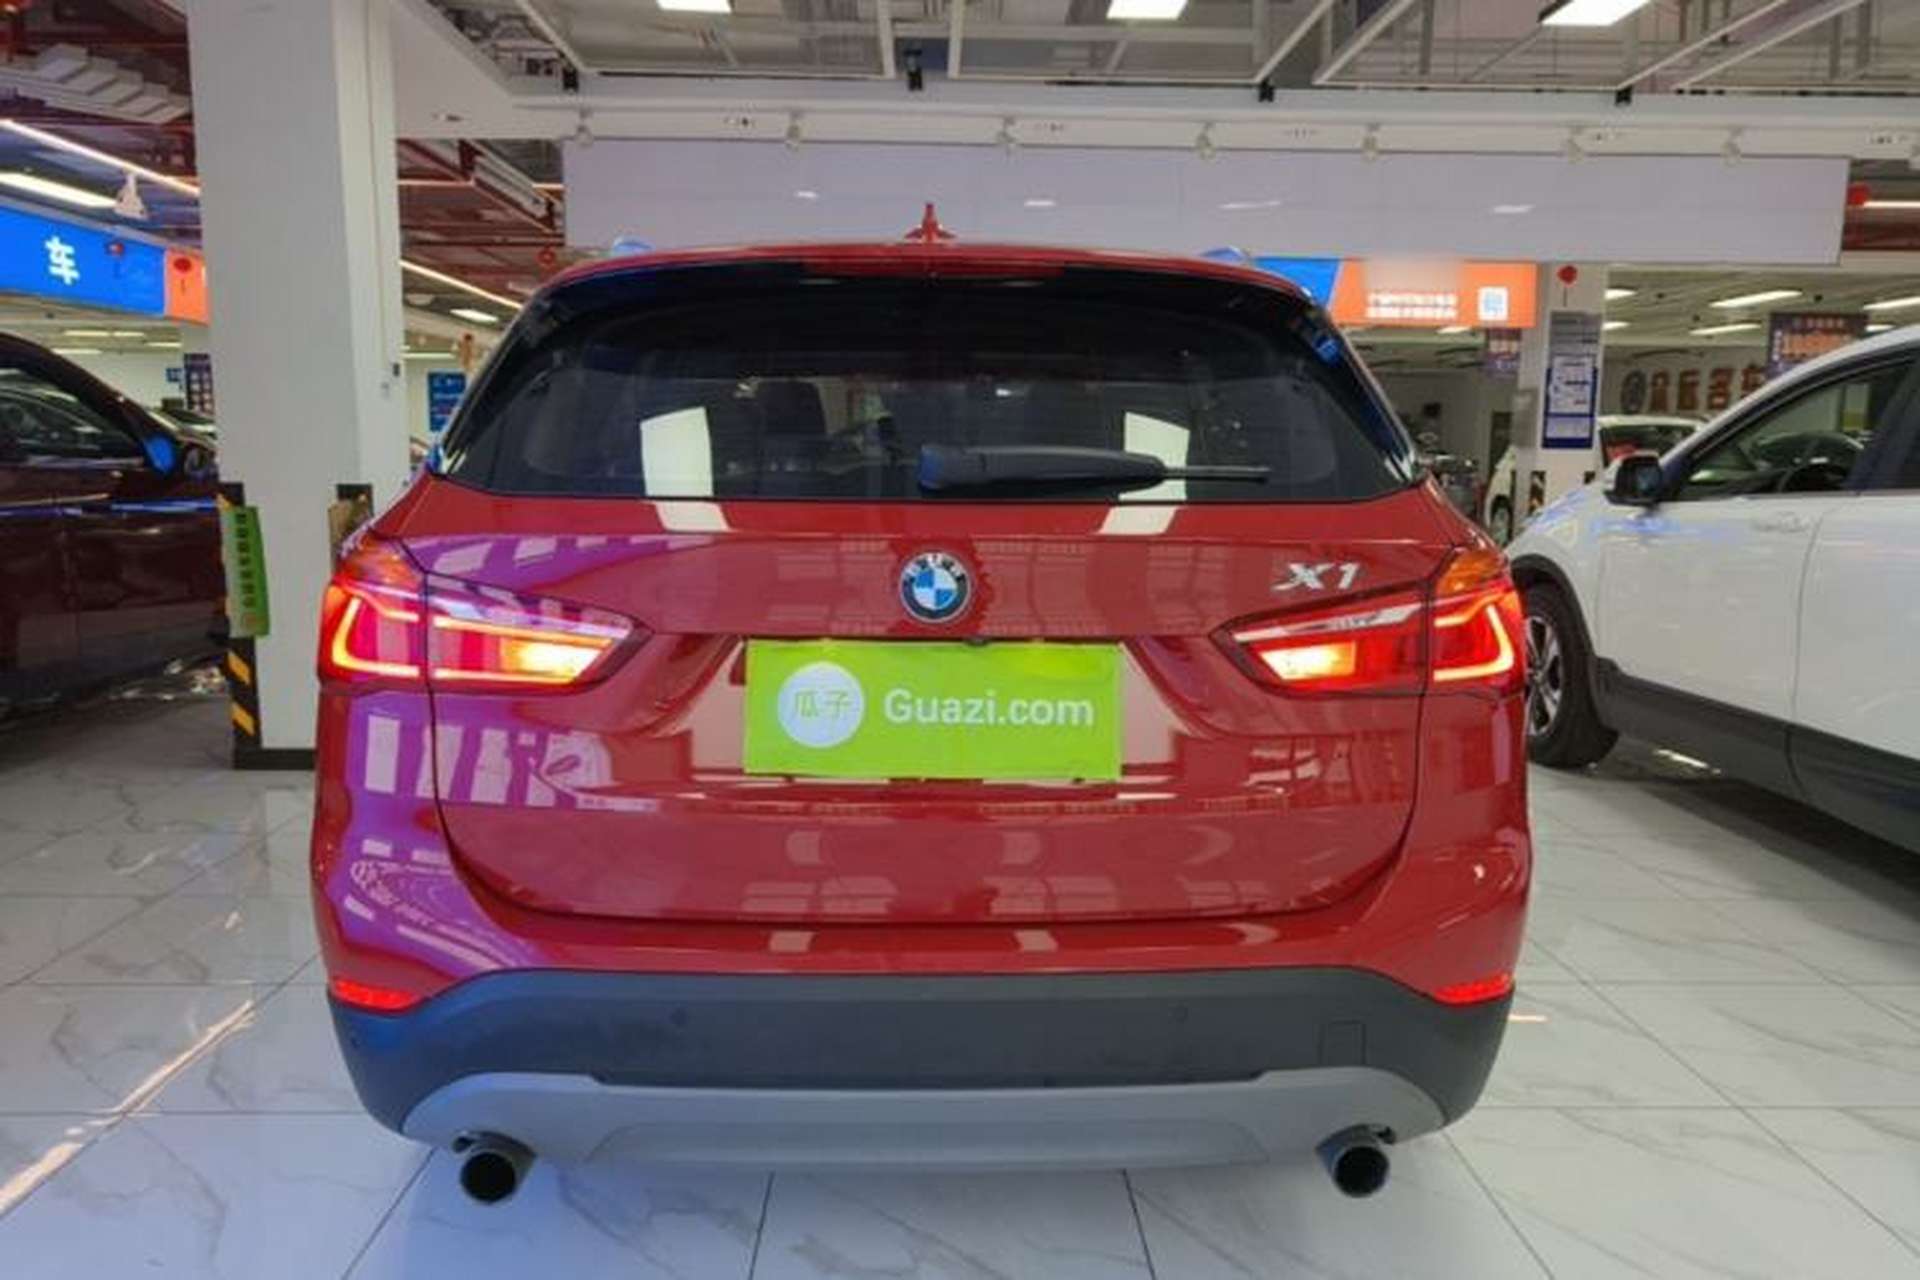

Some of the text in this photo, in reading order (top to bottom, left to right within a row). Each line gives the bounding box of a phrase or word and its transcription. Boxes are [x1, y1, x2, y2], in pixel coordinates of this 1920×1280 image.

[45, 236, 80, 284] 车
[1271, 562, 1359, 589] X1
[794, 690, 851, 719] 瓜子
[885, 688, 1094, 726] Guazi.com
